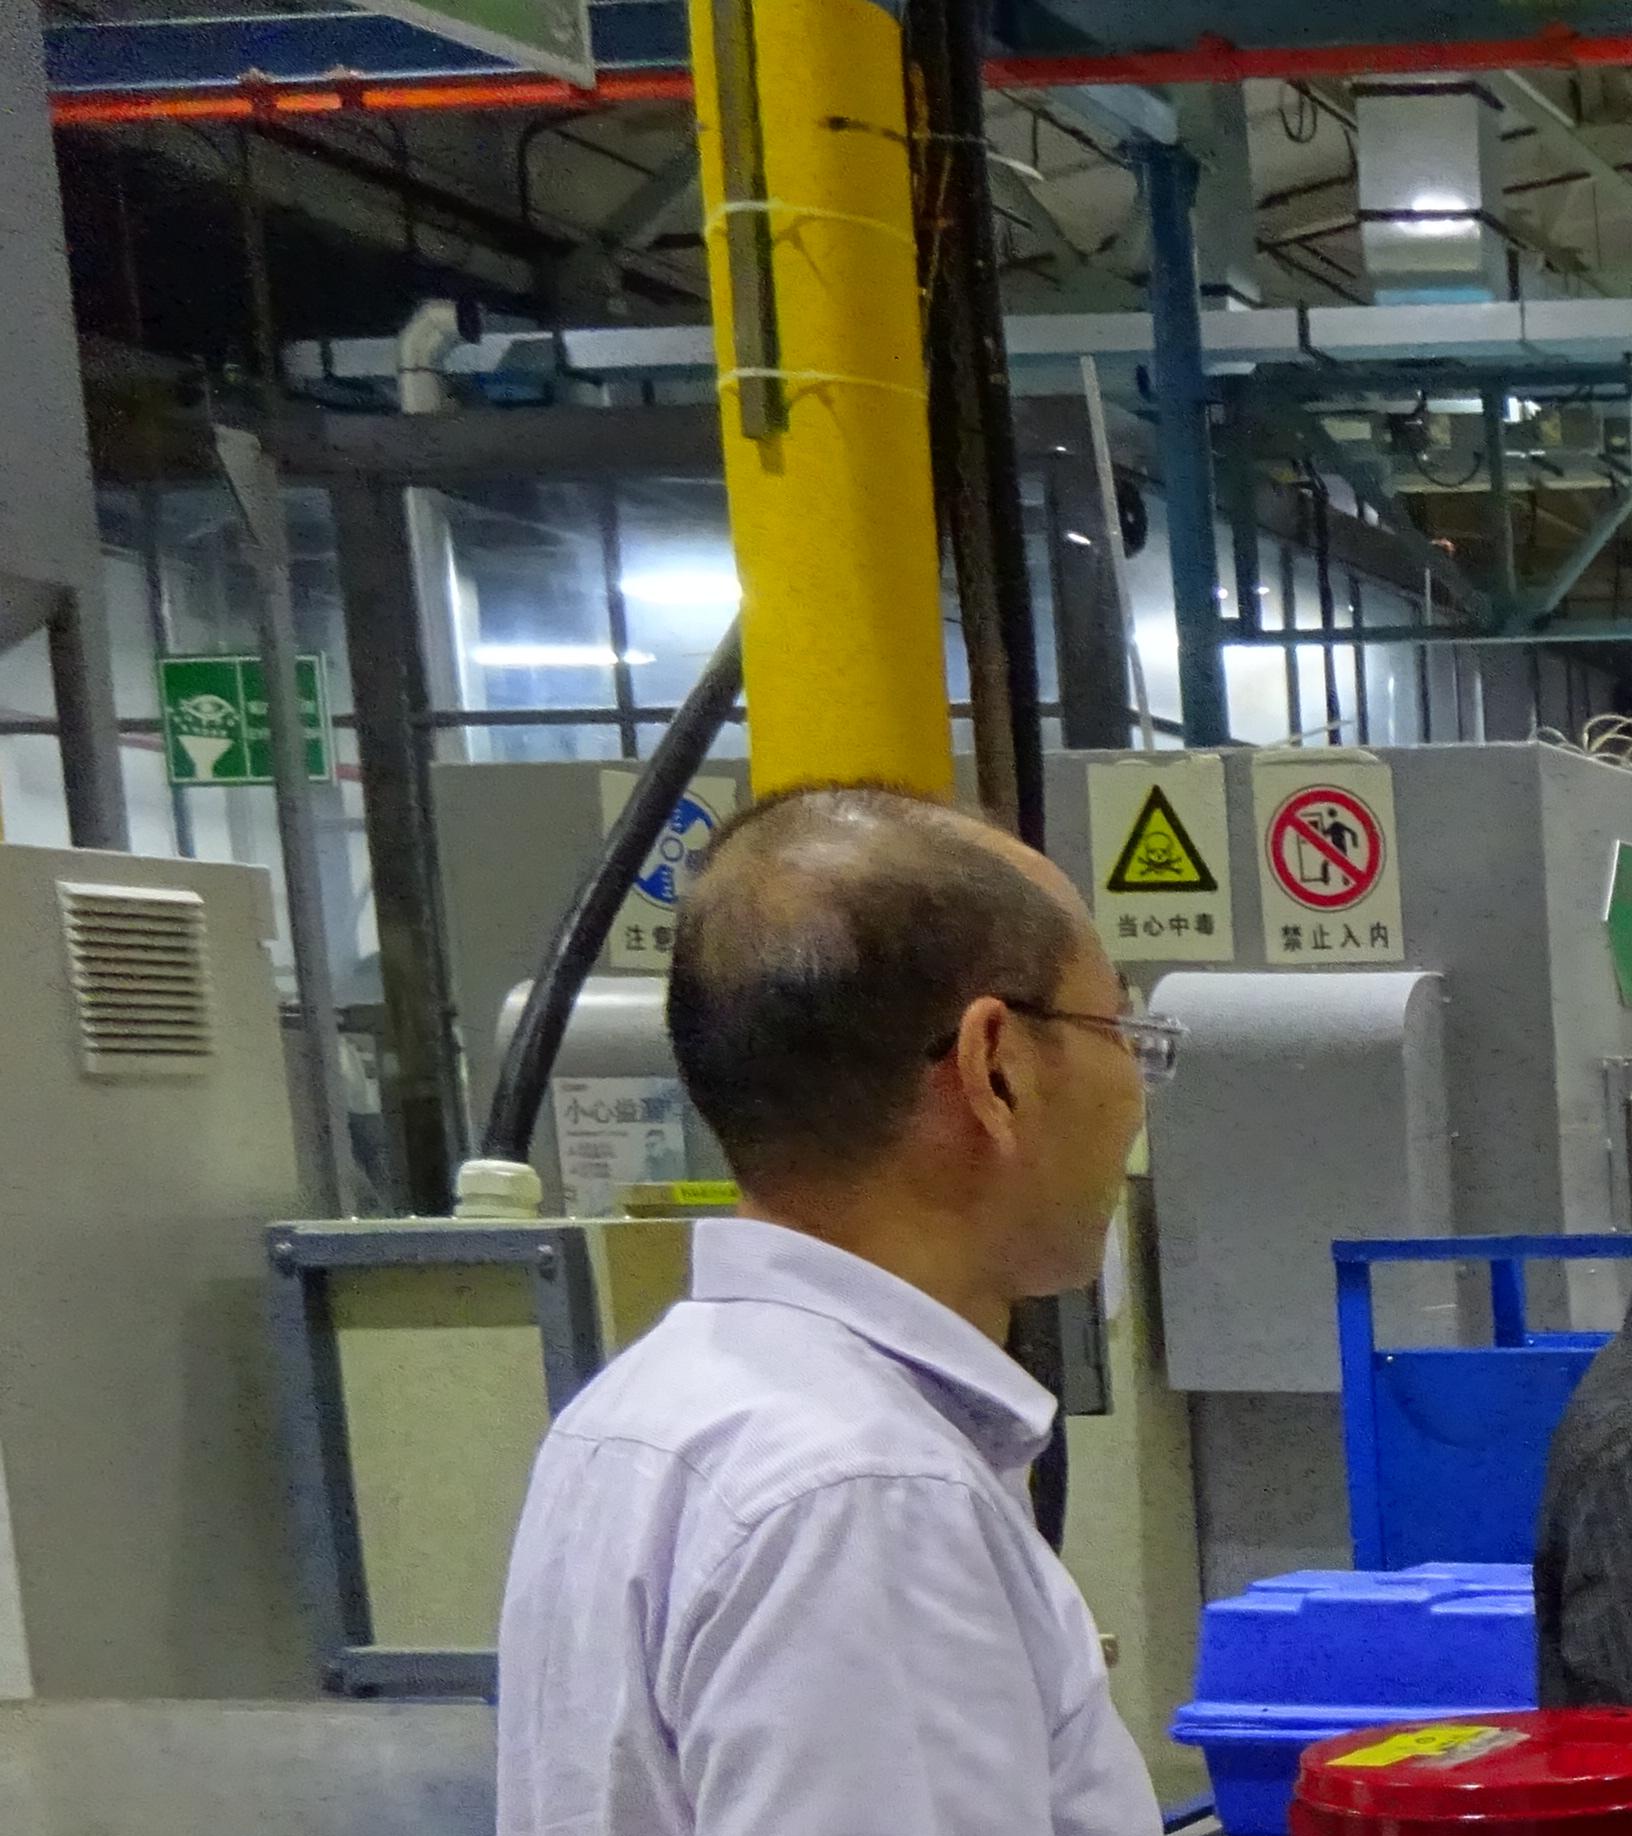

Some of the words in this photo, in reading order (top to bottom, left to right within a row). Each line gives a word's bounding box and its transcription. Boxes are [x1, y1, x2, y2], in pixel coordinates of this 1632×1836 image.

[1118, 912, 1216, 938] 当心中毒
[1281, 921, 1390, 952] 禁止入内
